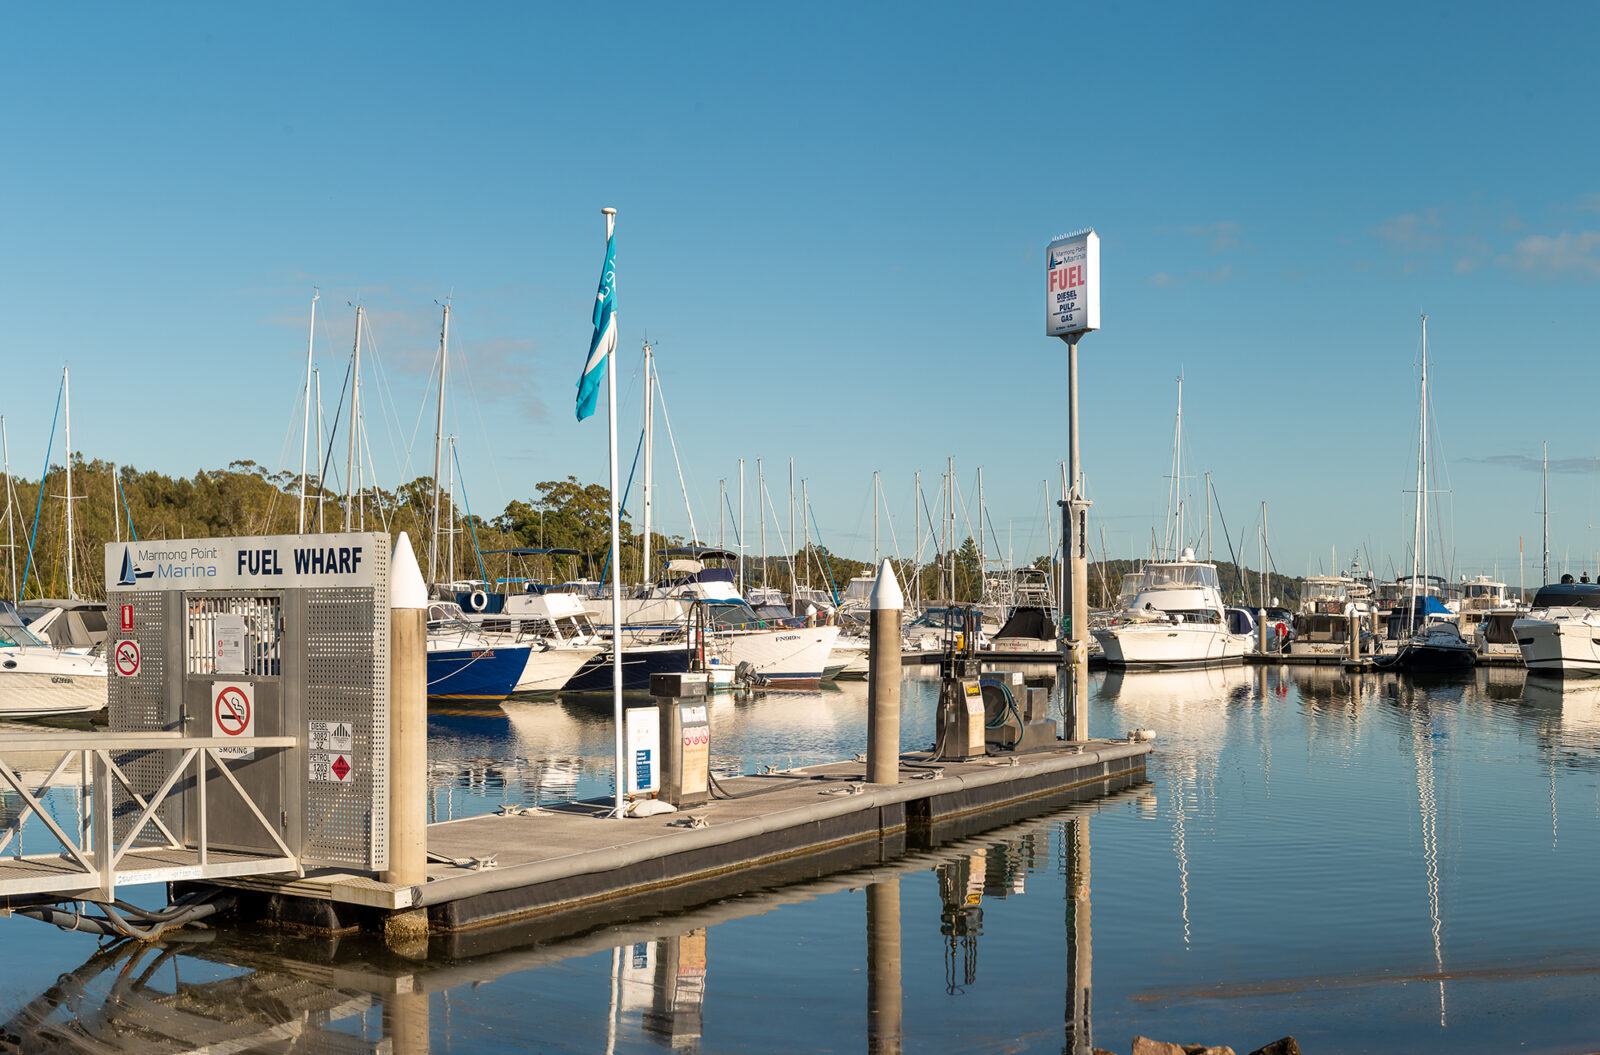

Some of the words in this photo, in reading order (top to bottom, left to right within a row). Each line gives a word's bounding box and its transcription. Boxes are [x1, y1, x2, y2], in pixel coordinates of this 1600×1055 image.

[1064, 253, 1086, 263] Marina
[1050, 265, 1085, 292] FUEL
[1057, 290, 1077, 301] DIESEL
[1059, 302, 1075, 311] PULP
[1061, 314, 1073, 323] GAS
[138, 549, 187, 562] Marmong
[190, 547, 217, 559] Point
[237, 549, 283, 575] FUEL
[293, 547, 362, 574] WHARF
[158, 563, 217, 578] Marina
[310, 722, 329, 731] DIESEL
[313, 732, 328, 741] 3082
[316, 741, 324, 750] 3Z
[309, 753, 330, 762] PETROL
[313, 763, 328, 772] 1203
[315, 772, 327, 781] 3YE
